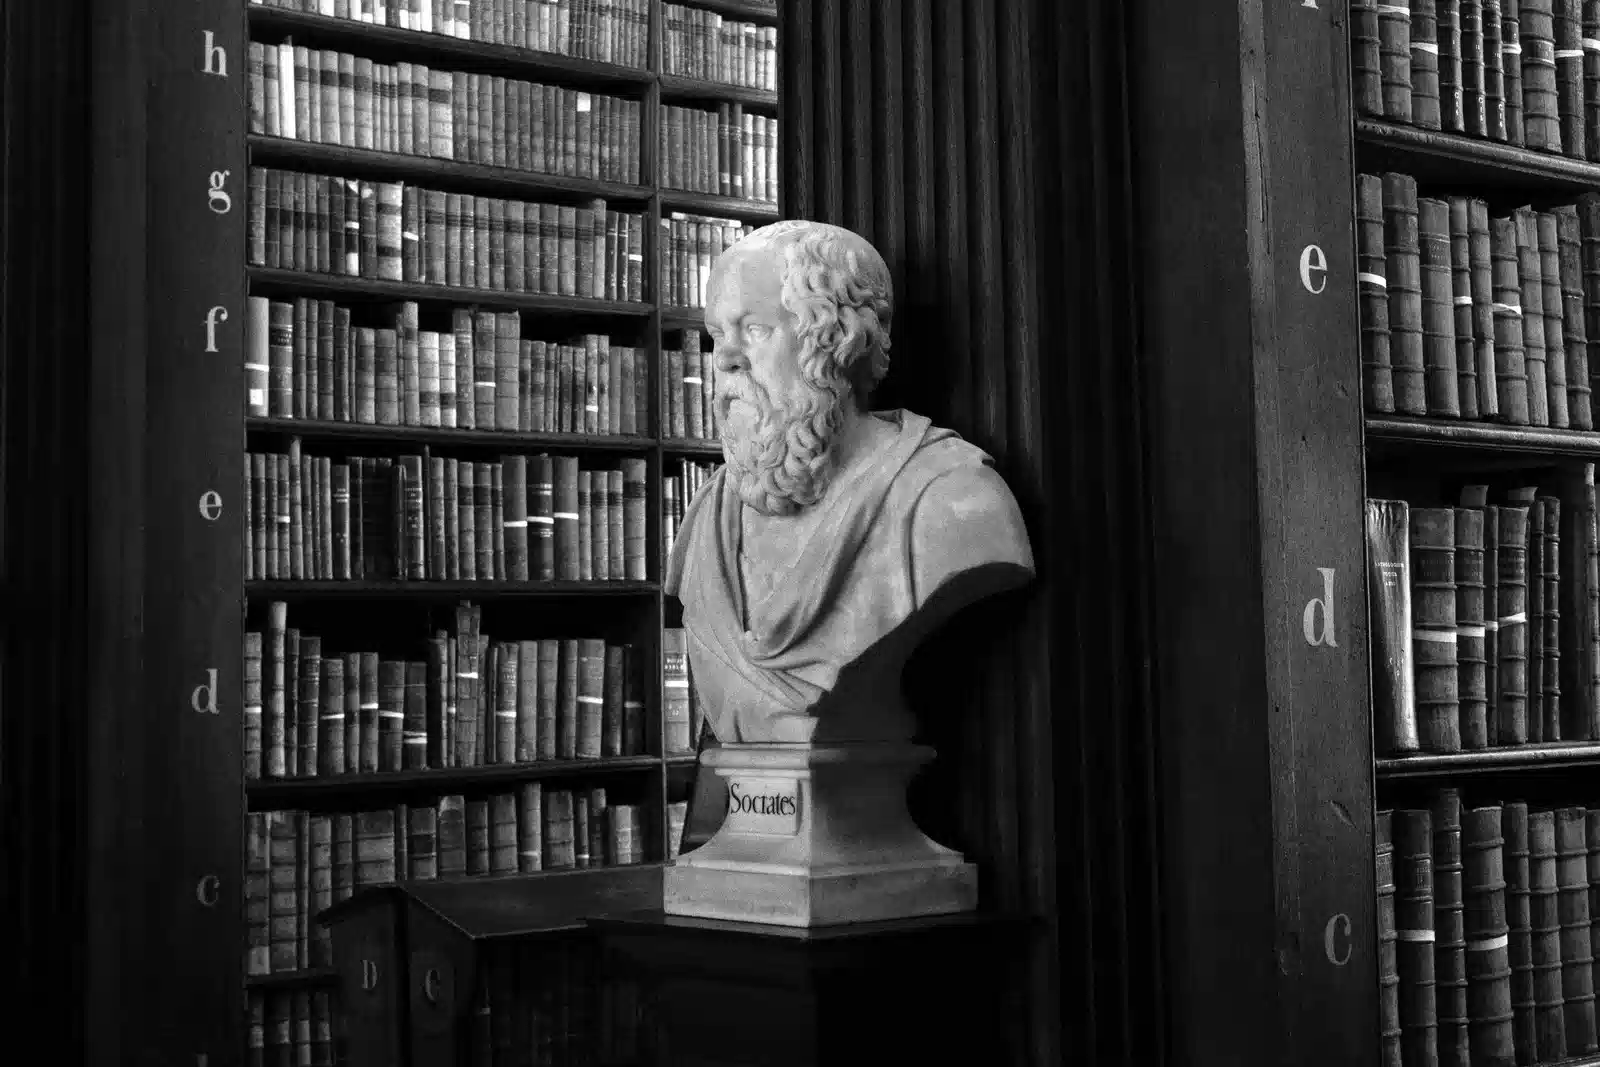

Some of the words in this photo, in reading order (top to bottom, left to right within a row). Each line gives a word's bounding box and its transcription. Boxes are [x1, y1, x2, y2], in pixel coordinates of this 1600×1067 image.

[202, 30, 228, 77] h
[207, 169, 231, 214] g
[1299, 244, 1328, 295] e
[204, 305, 229, 353] f
[198, 490, 223, 521] e
[1302, 566, 1338, 649] d
[191, 668, 220, 715] d
[730, 782, 796, 816] Socrates
[196, 875, 221, 907] c
[1324, 912, 1353, 967] c
[361, 959, 378, 990] D
